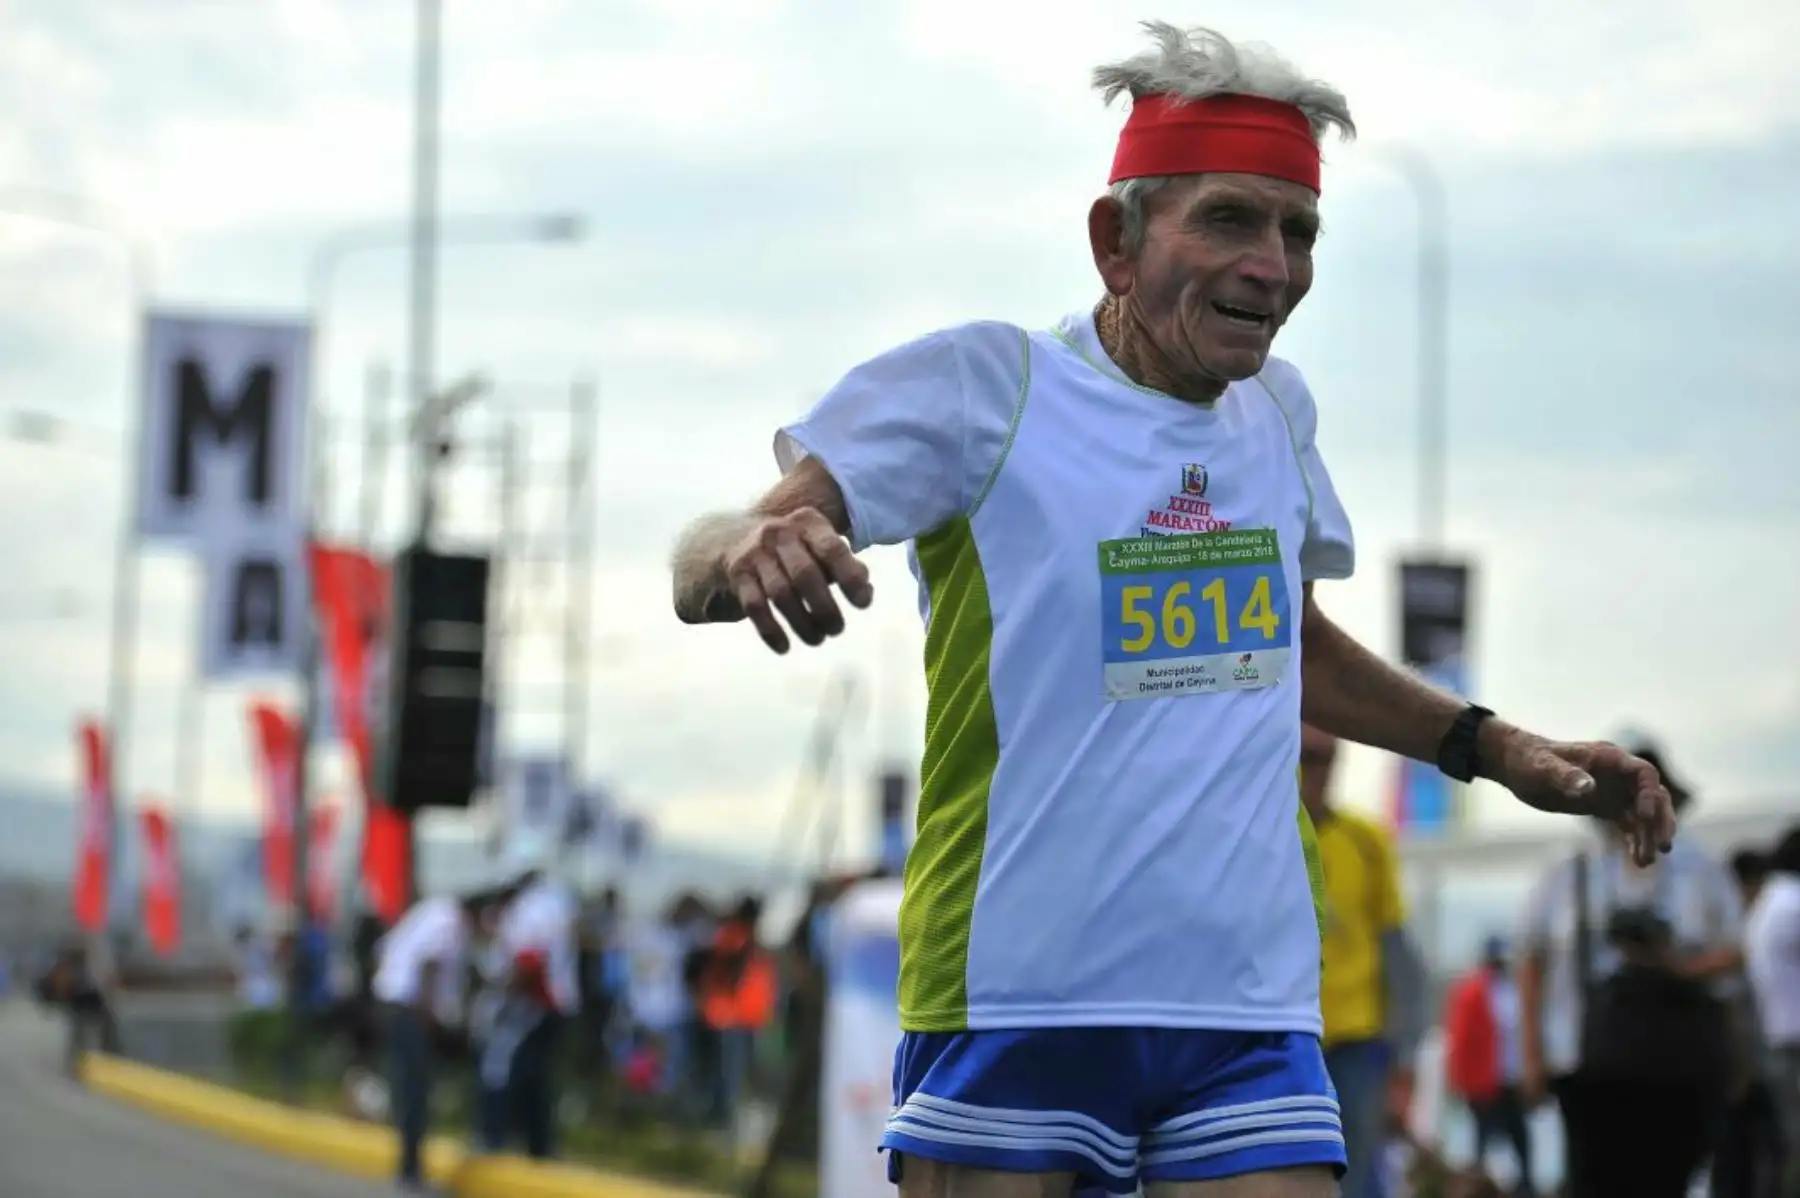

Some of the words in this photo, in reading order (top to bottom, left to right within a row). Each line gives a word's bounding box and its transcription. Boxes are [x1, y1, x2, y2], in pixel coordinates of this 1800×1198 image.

[167, 355, 279, 507] M
[1146, 510, 1232, 533] MARATÓN
[1167, 496, 1213, 517] XXXIII
[1120, 575, 1280, 653] 5614
